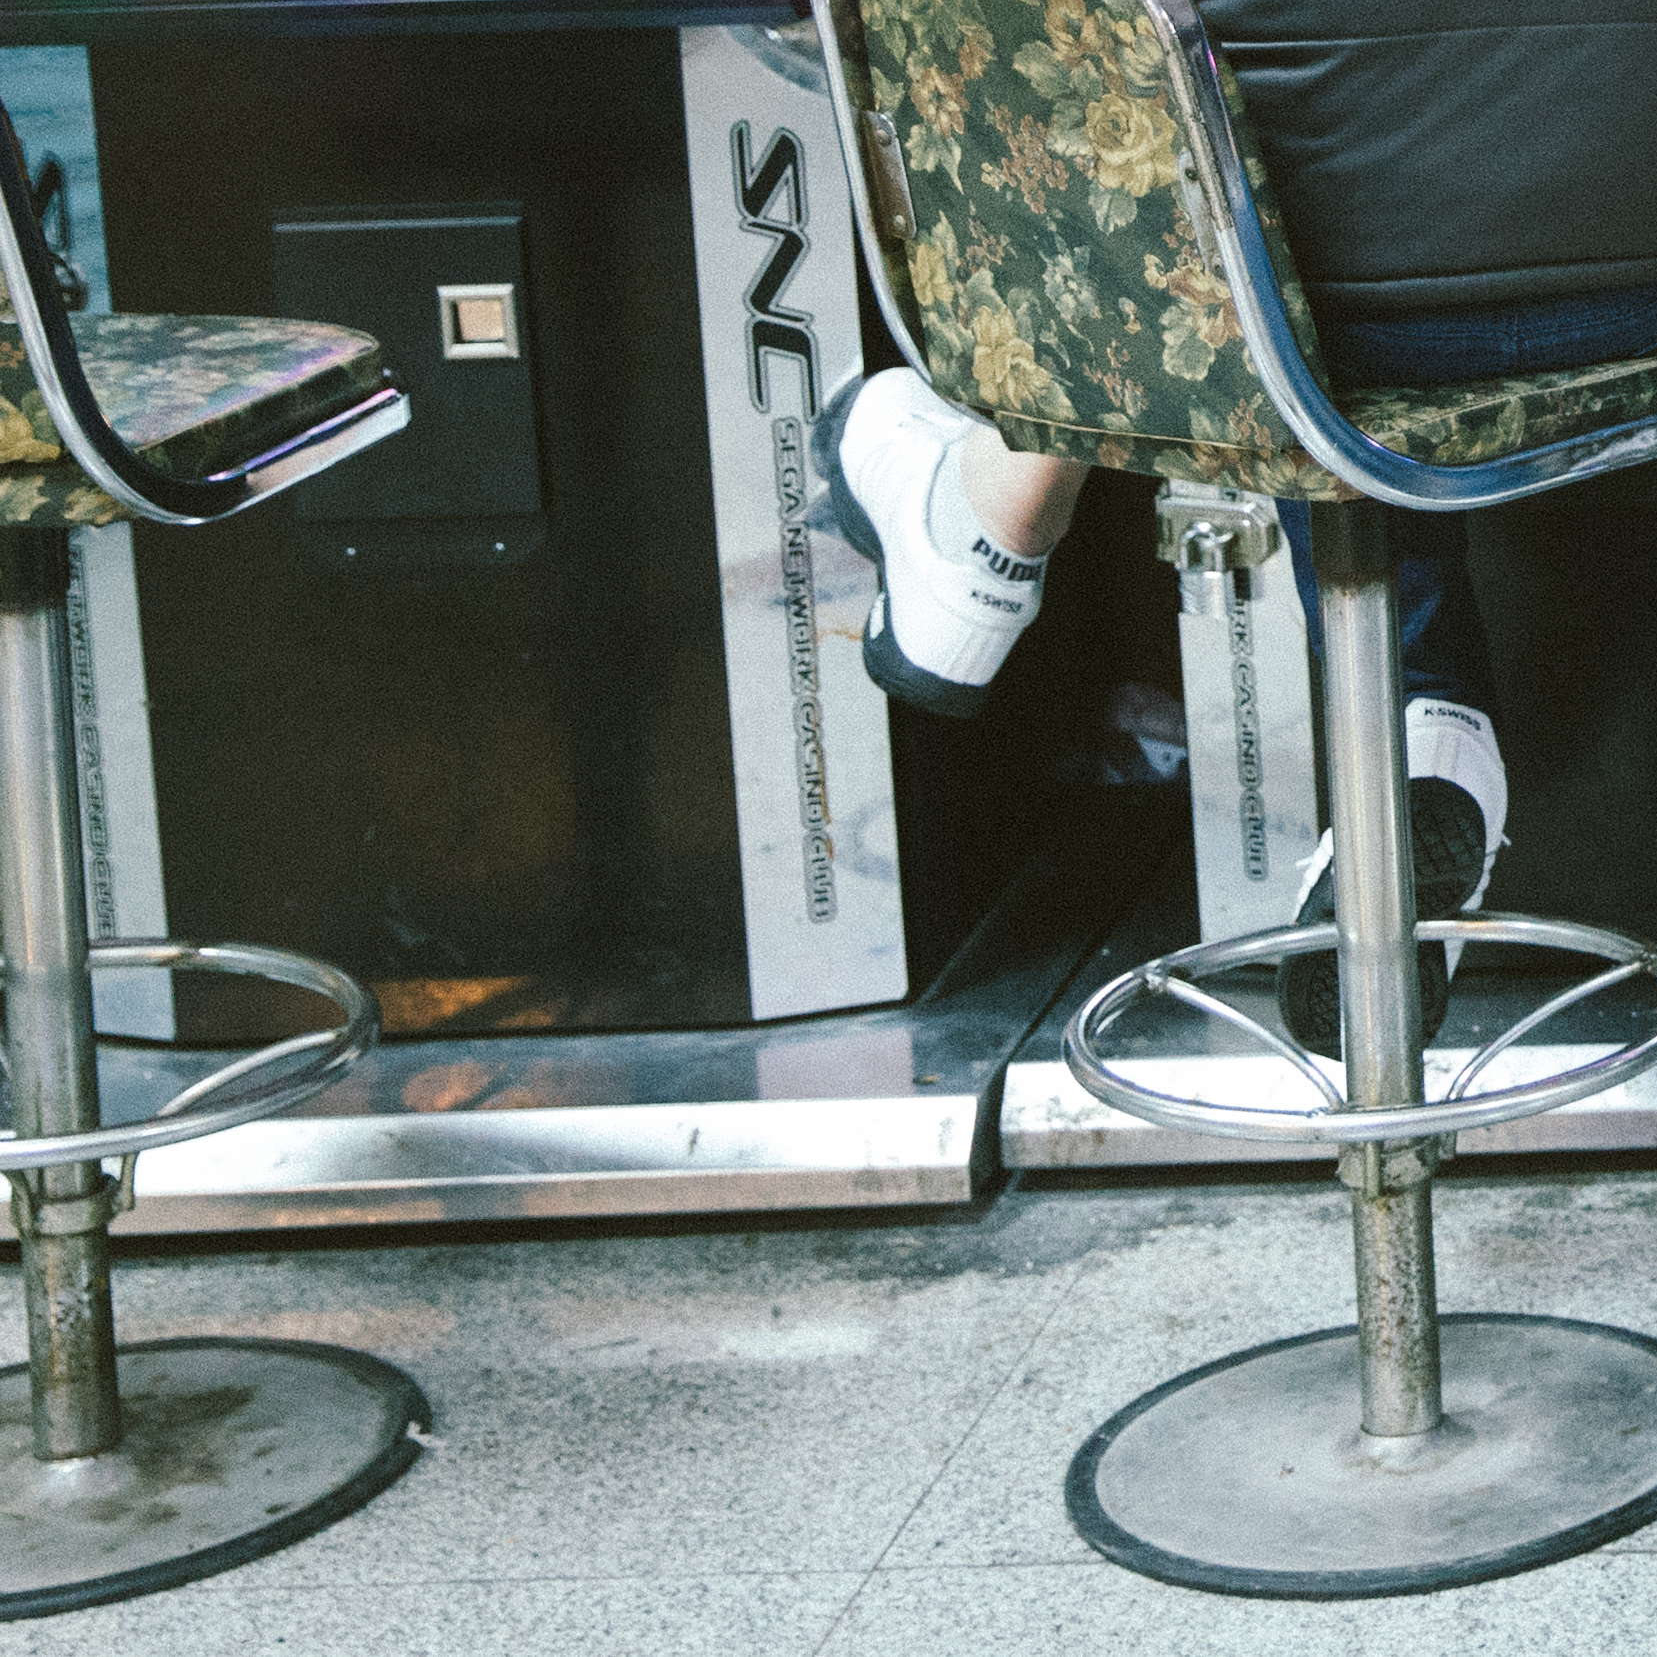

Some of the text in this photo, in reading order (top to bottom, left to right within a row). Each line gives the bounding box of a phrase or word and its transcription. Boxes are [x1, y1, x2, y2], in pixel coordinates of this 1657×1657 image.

[730, 119, 822, 425] SNC
[772, 416, 808, 520] SEGA
[780, 520, 820, 696] NETWORK
